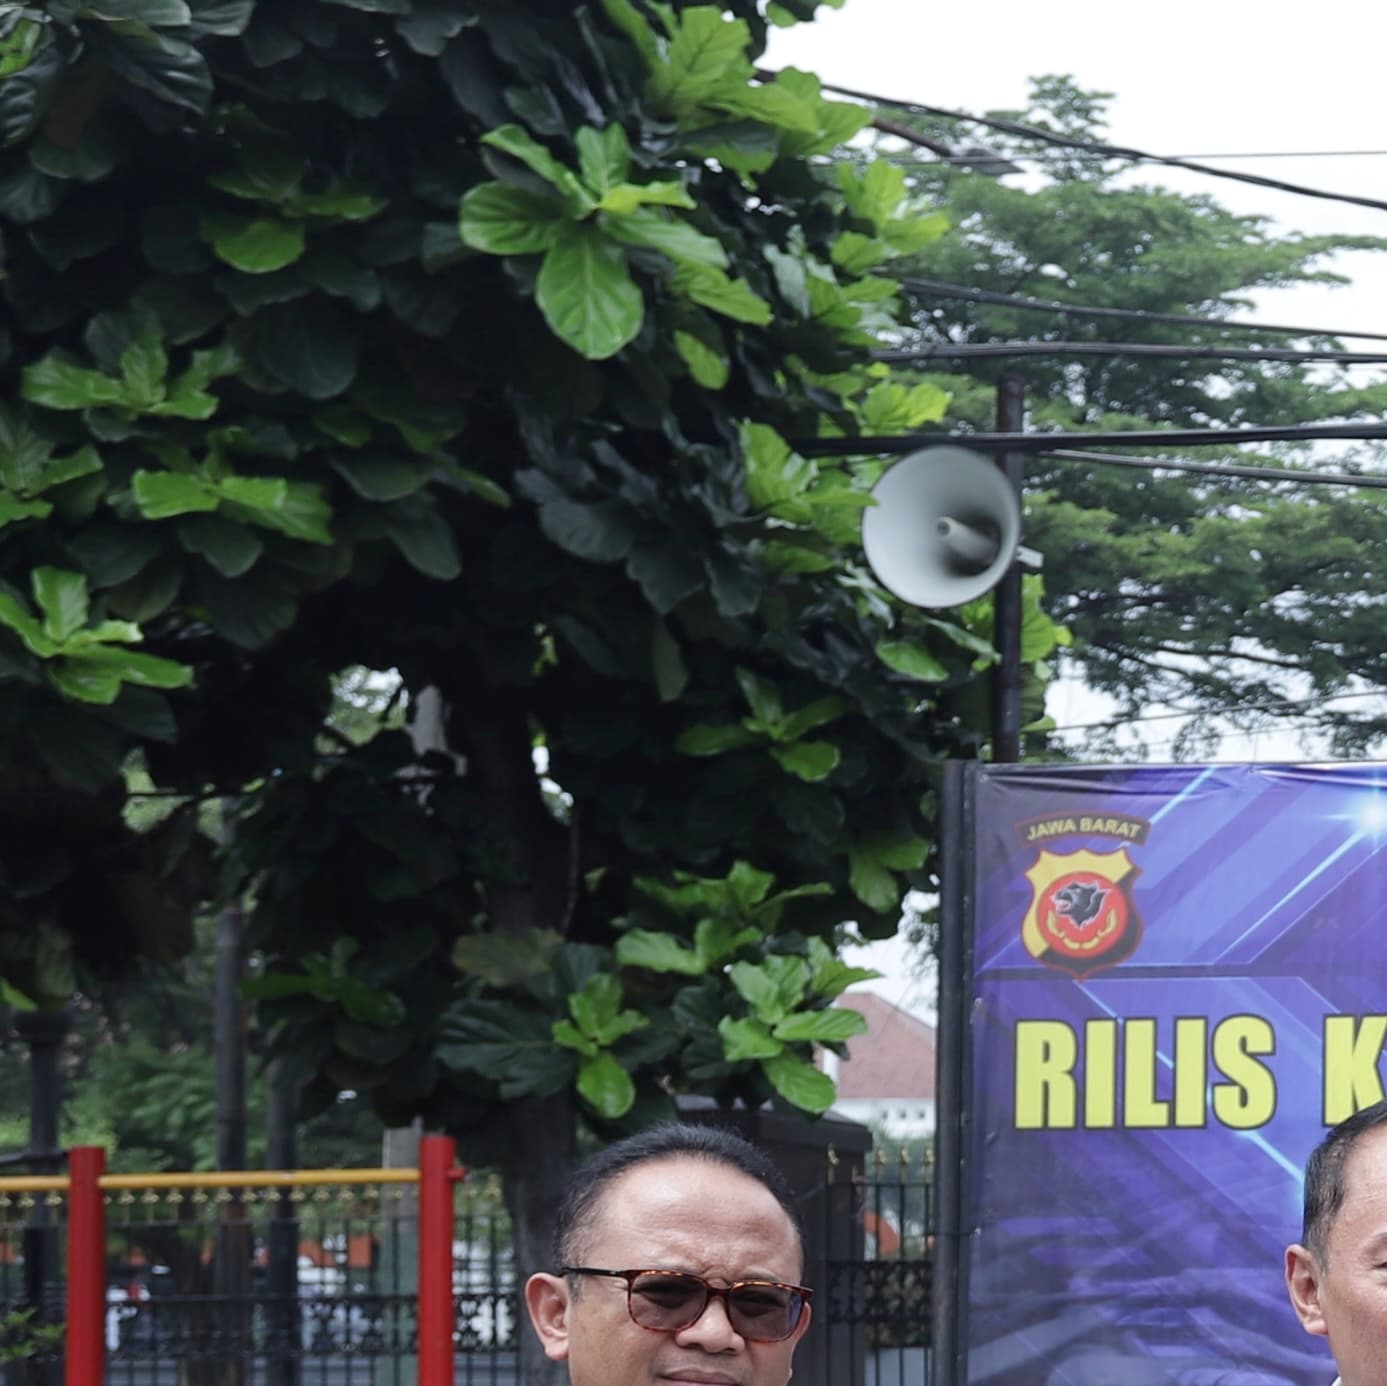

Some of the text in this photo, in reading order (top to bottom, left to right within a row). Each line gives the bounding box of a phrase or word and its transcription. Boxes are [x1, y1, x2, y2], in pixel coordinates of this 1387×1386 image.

[1026, 817, 1142, 841] JAWA BARAT
[1014, 1014, 1277, 1132] RILIS
